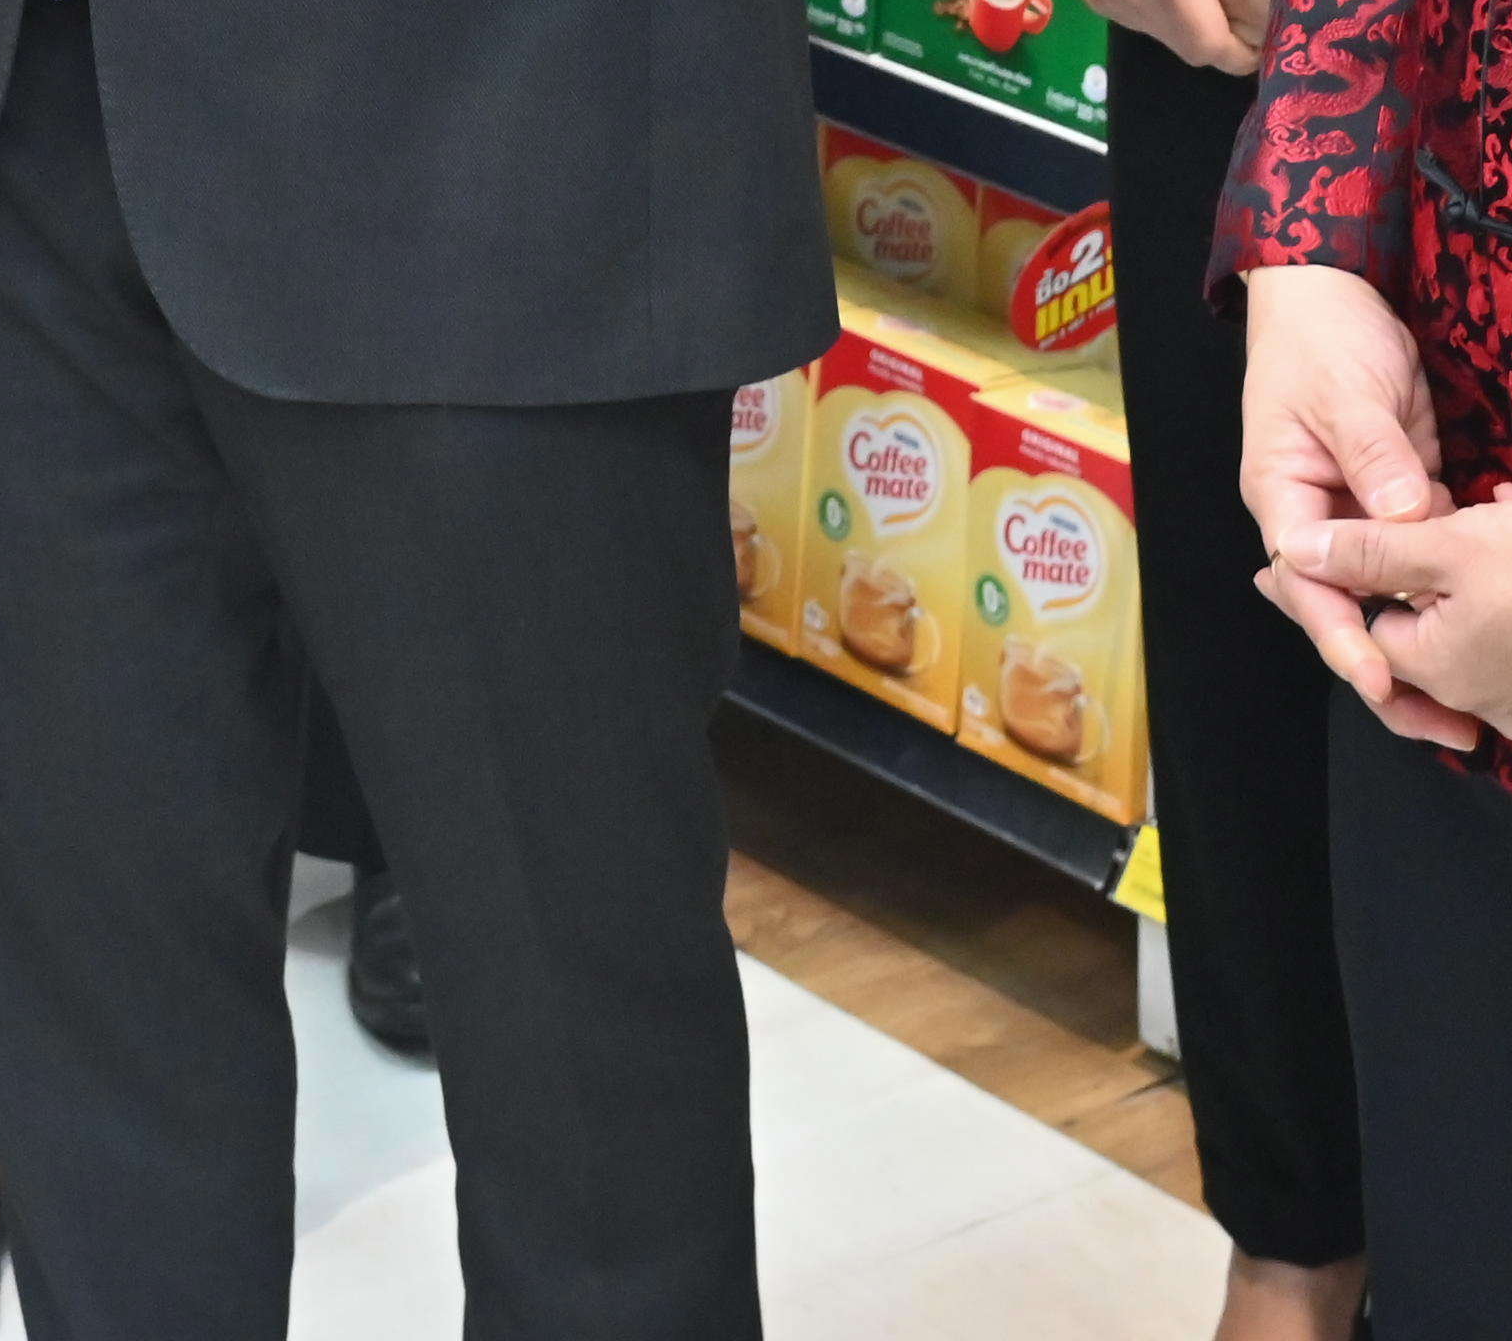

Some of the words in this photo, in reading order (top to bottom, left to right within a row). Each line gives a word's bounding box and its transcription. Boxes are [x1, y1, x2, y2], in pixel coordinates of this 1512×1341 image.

[849, 430, 927, 477] Coffee
[864, 473, 930, 502] mate
[1004, 513, 1089, 560] Coffee
[1021, 558, 1091, 586] mate
